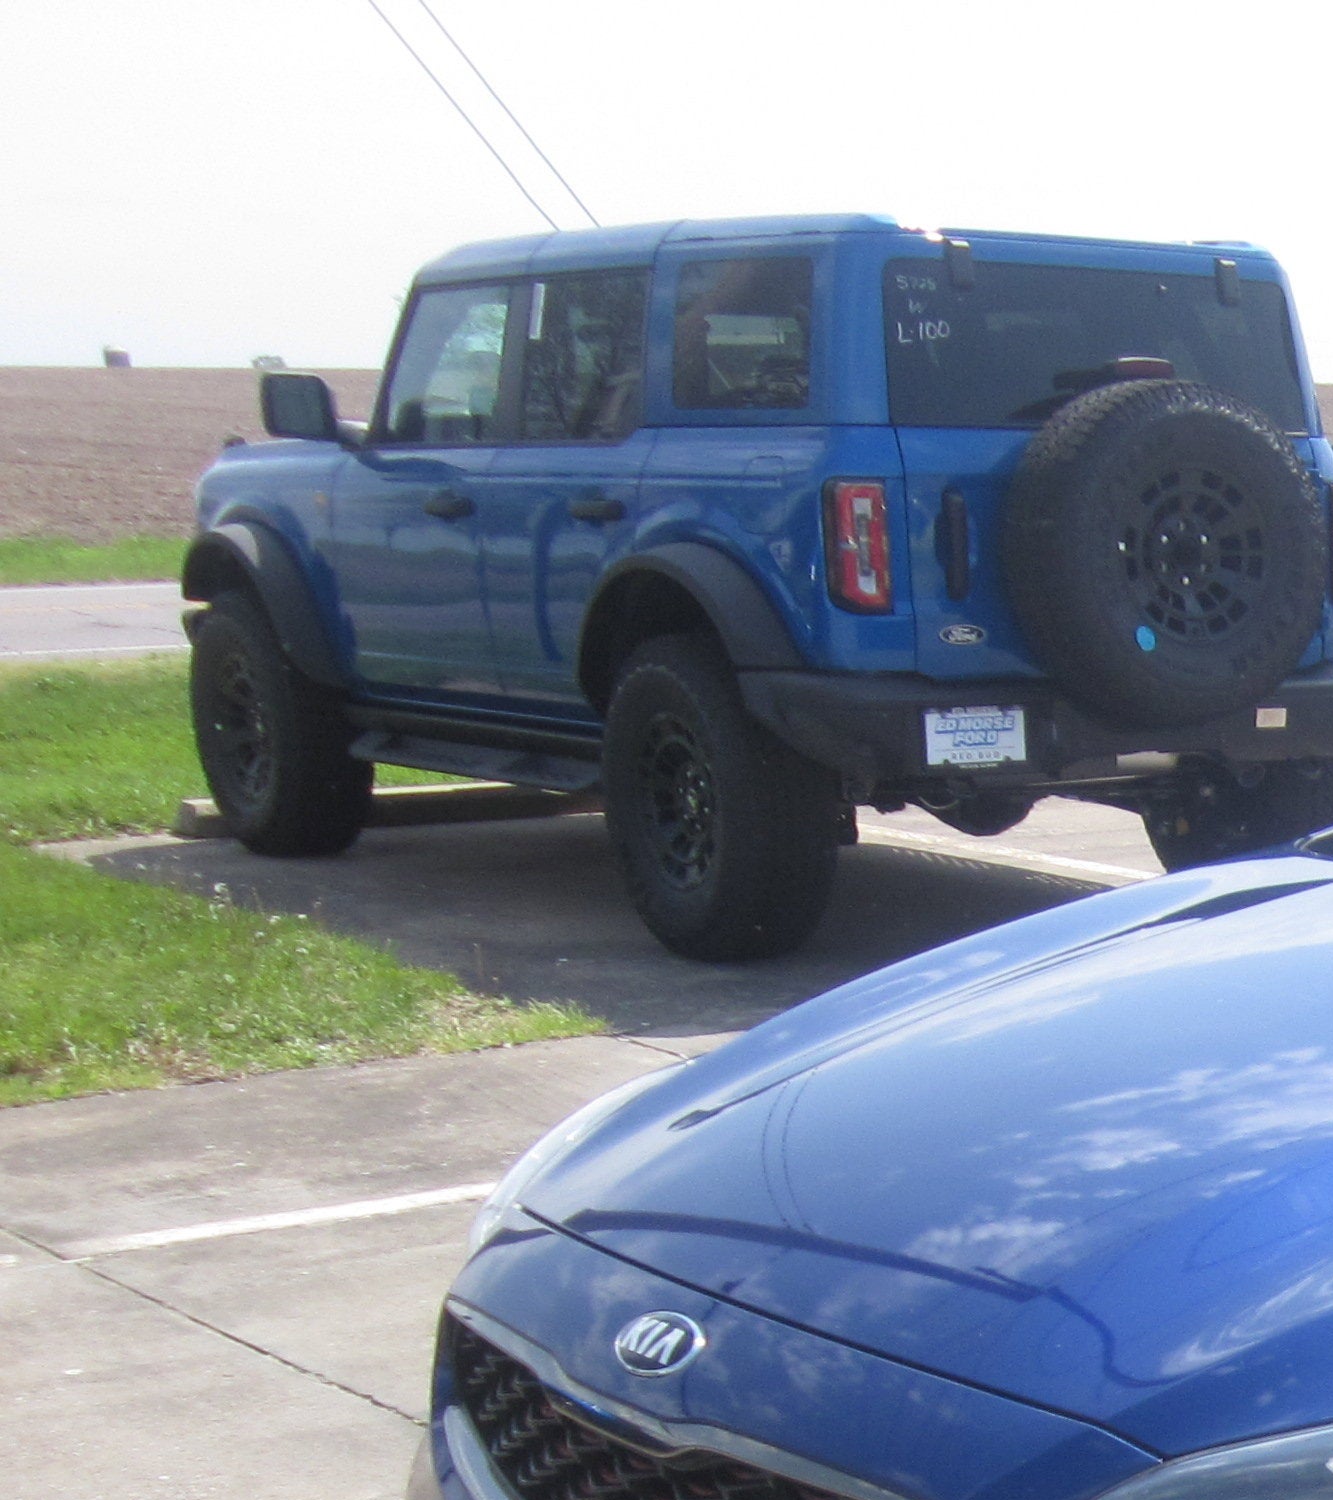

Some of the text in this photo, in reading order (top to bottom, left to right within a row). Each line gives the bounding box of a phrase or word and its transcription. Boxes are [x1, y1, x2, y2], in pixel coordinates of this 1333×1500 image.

[957, 715, 1014, 733] MORSE
[953, 731, 998, 747] FORD
[620, 1316, 686, 1366] KIA
